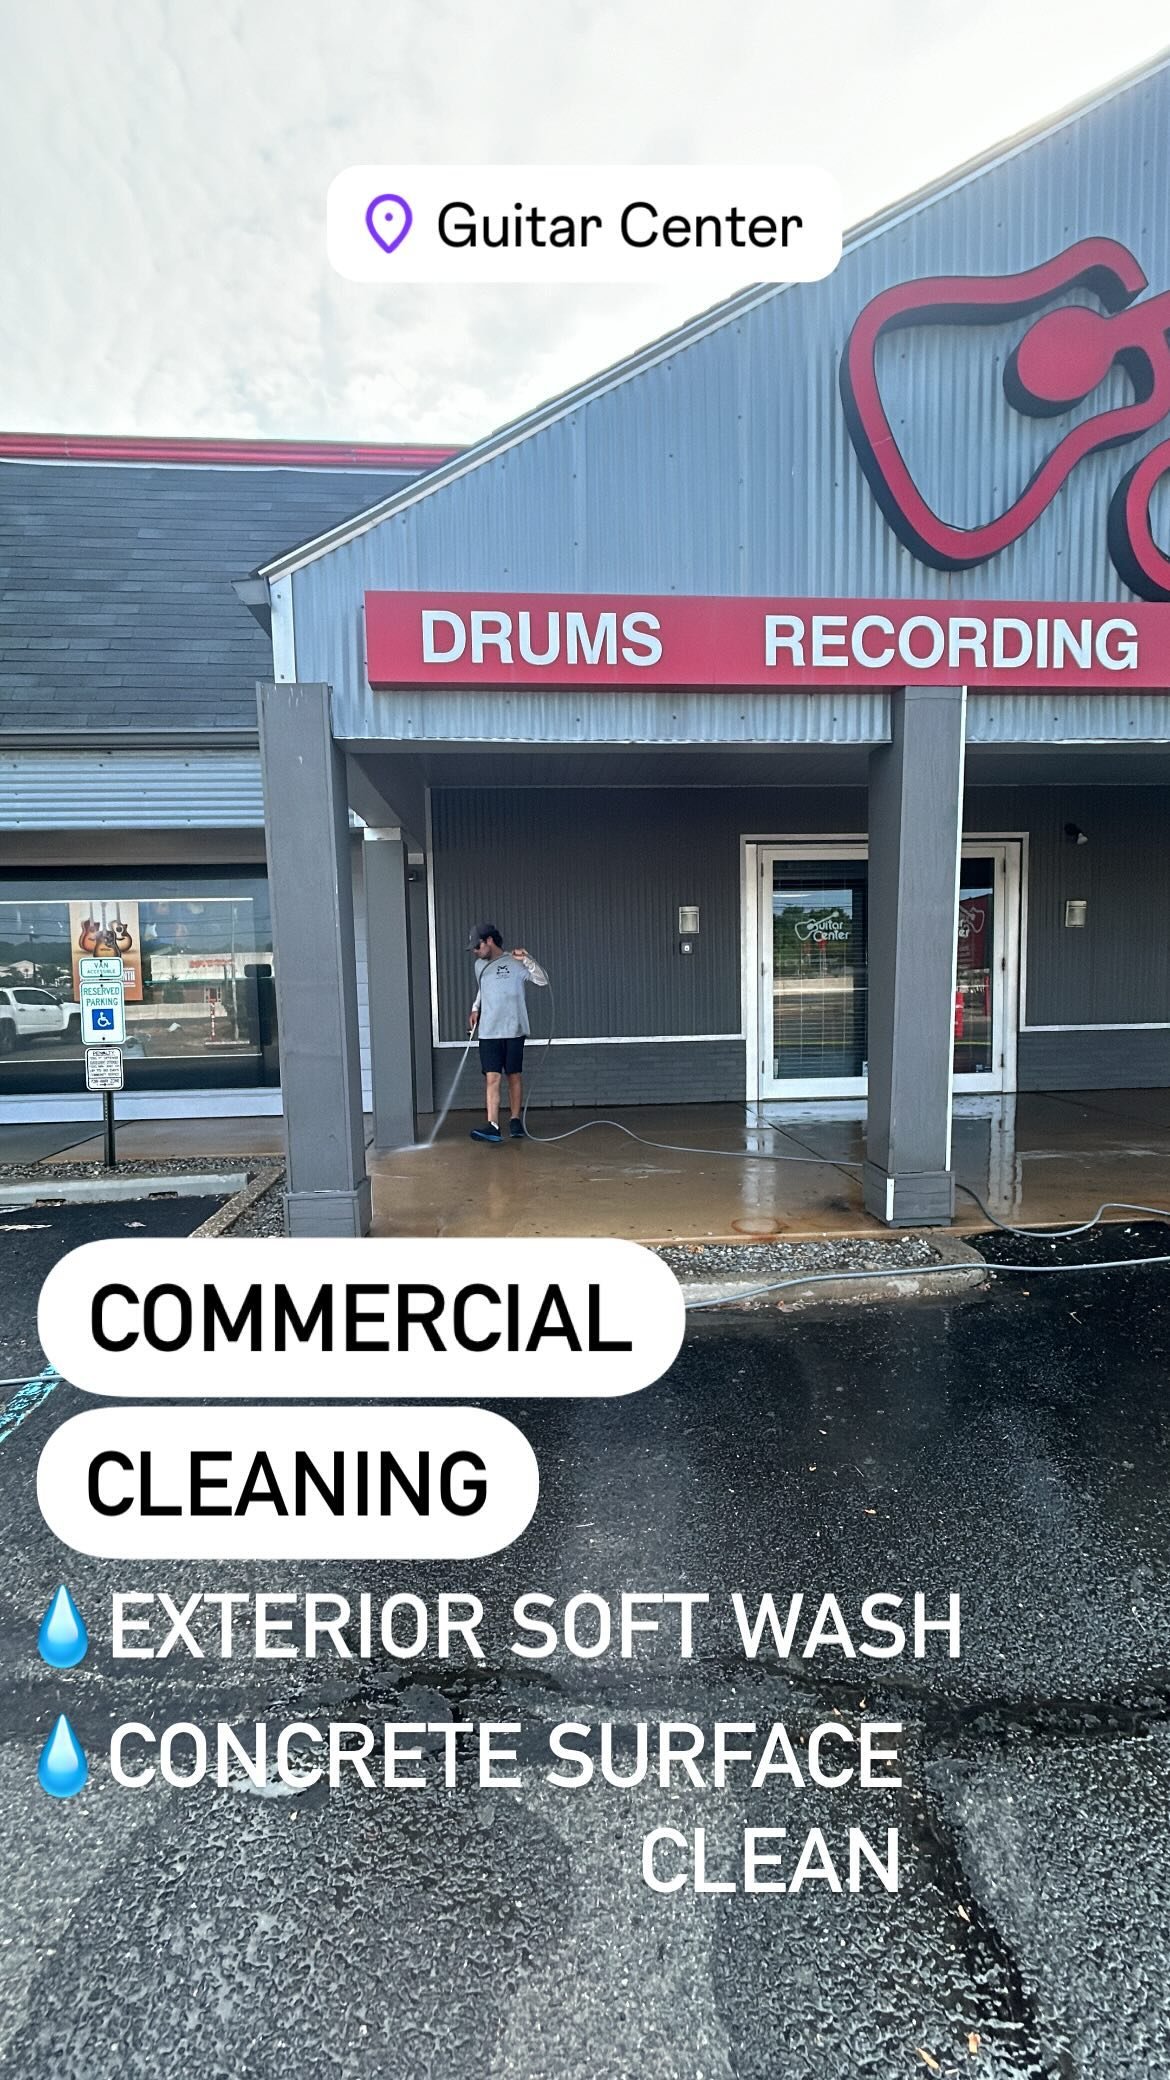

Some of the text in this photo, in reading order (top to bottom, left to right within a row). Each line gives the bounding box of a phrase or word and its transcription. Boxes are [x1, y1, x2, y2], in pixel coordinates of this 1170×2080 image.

[421, 610, 1138, 671] DRUMS RECORDING
[813, 930, 849, 942] Center
[83, 987, 120, 996] RESERVED
[86, 998, 118, 1006] PARKING
